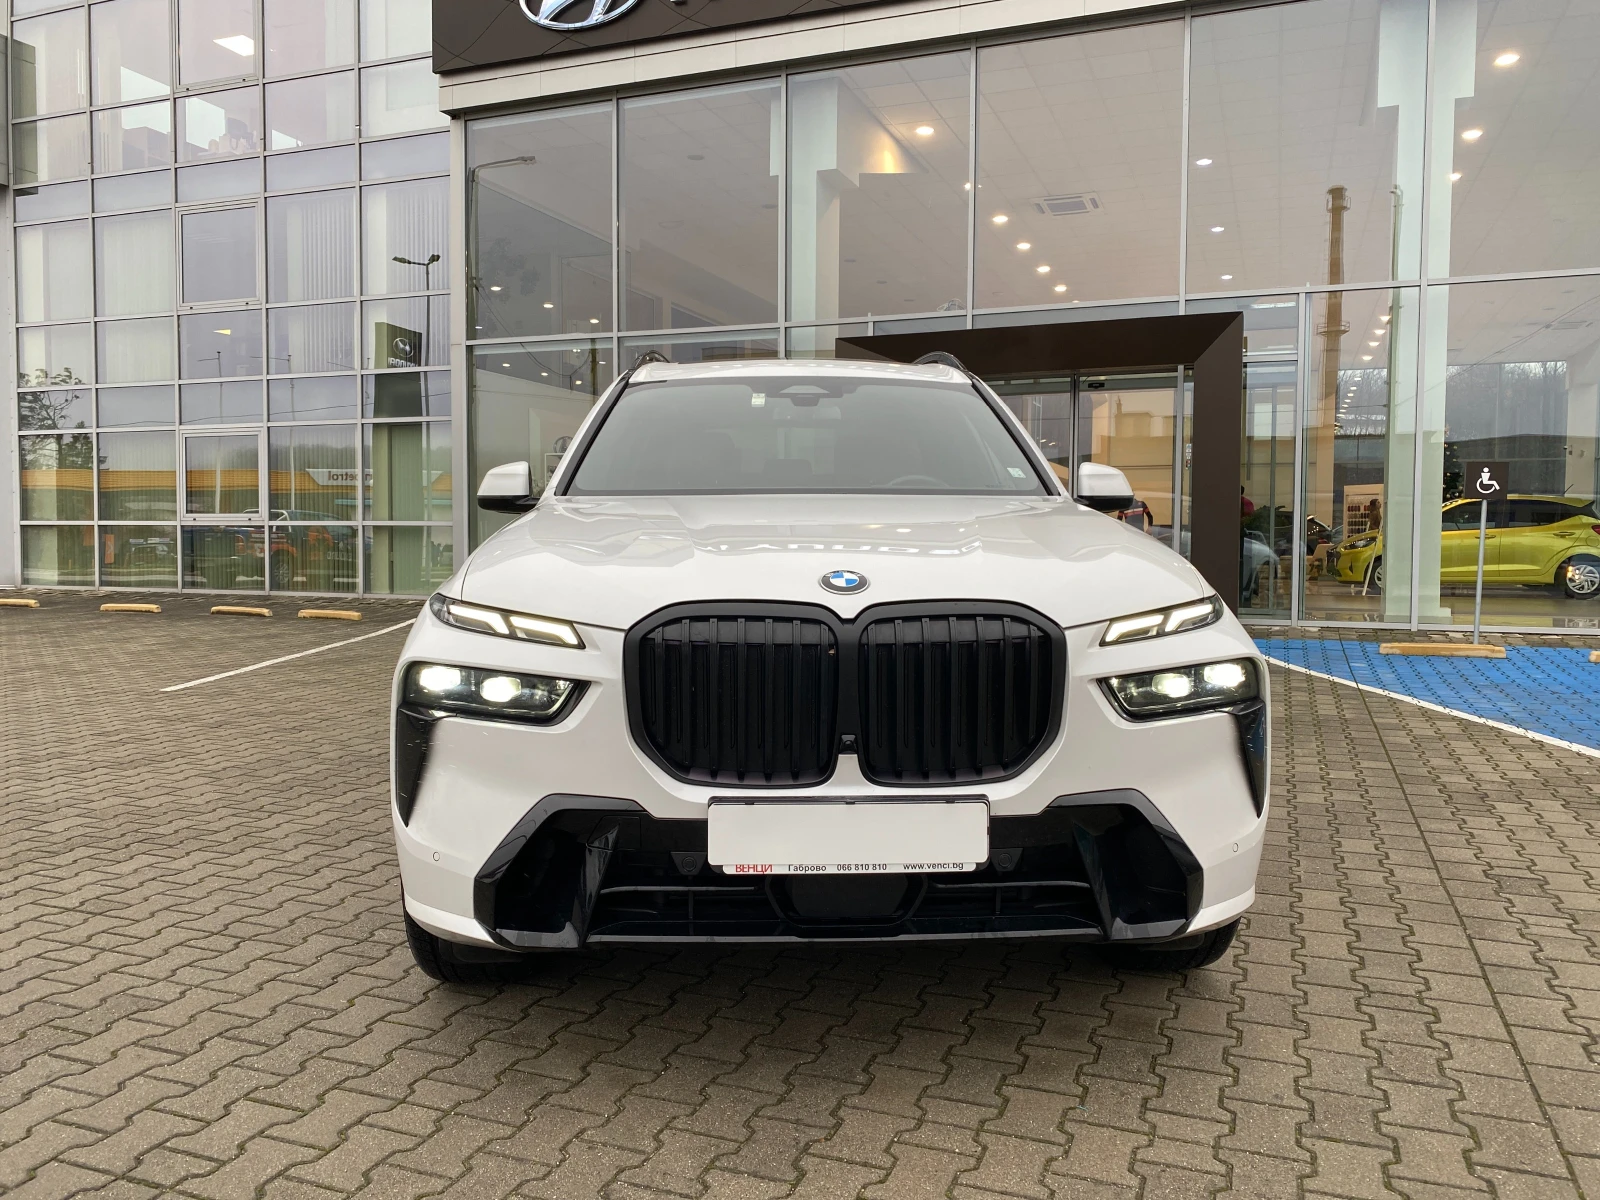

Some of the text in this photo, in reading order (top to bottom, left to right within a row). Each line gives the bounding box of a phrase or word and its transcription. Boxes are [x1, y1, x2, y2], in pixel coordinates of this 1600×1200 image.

[735, 862, 964, 874] ВЕНЦИ Габрово 066 810 810 www.venci.bg
